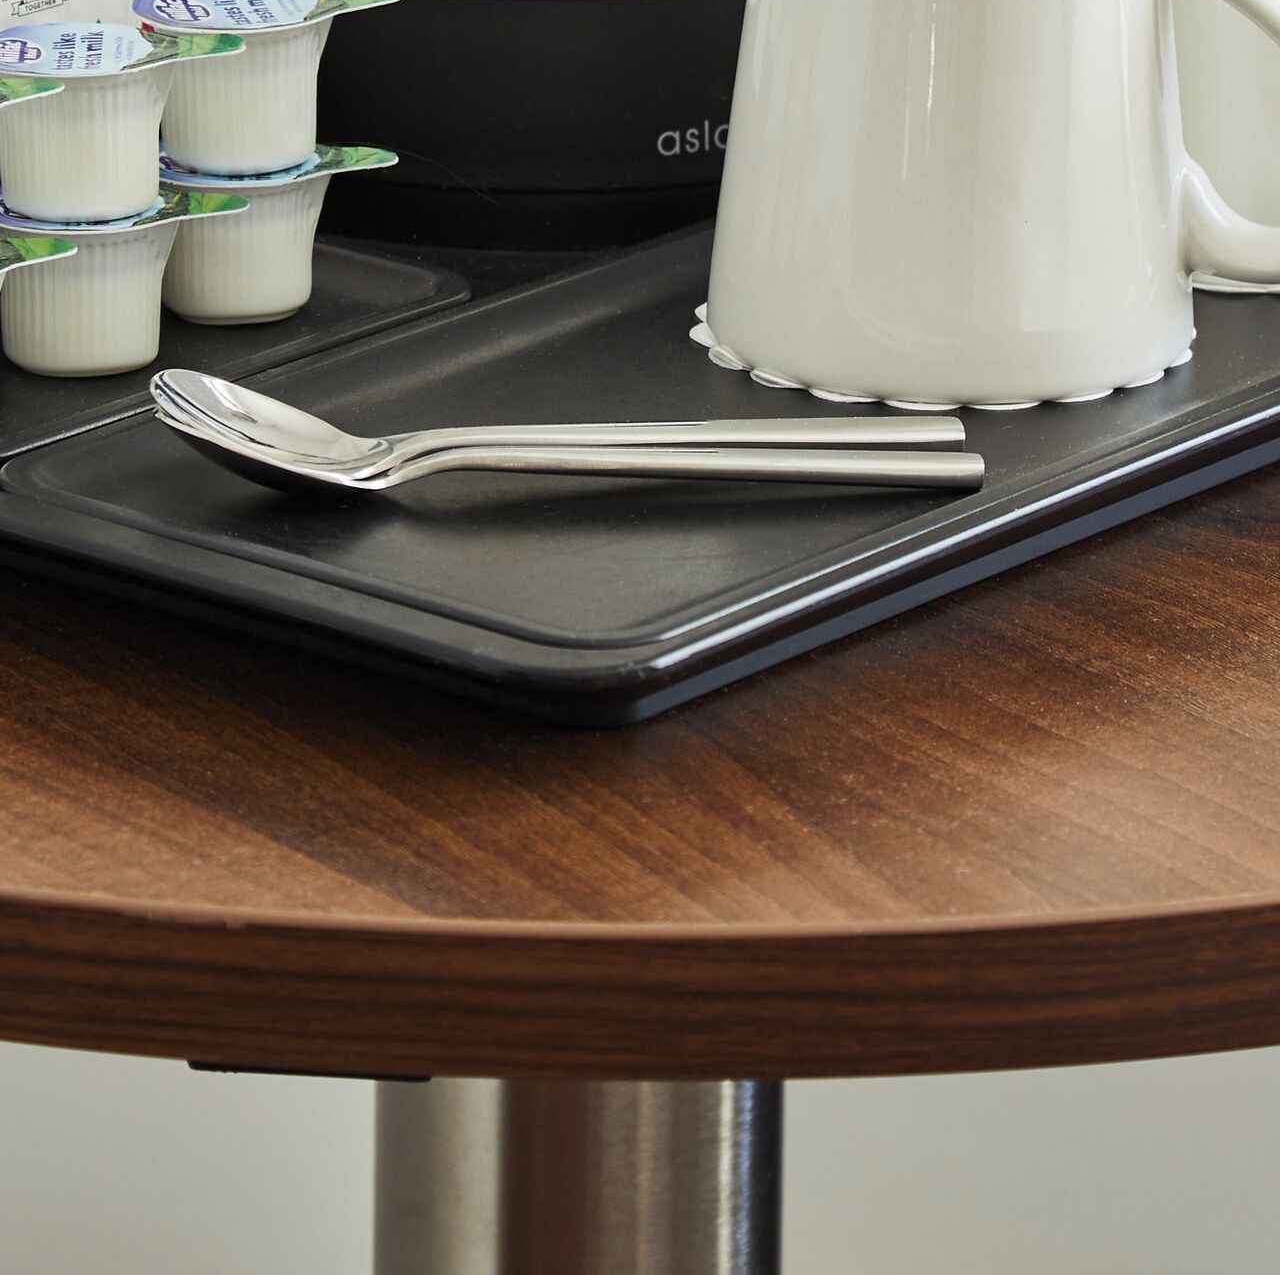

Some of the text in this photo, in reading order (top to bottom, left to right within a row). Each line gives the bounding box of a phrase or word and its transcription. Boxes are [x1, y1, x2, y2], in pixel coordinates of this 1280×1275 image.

[222, 7, 253, 25] tastes
[247, 7, 279, 23] fresh
[52, 33, 76, 70] tastes like
[77, 31, 103, 69] fresh milk
